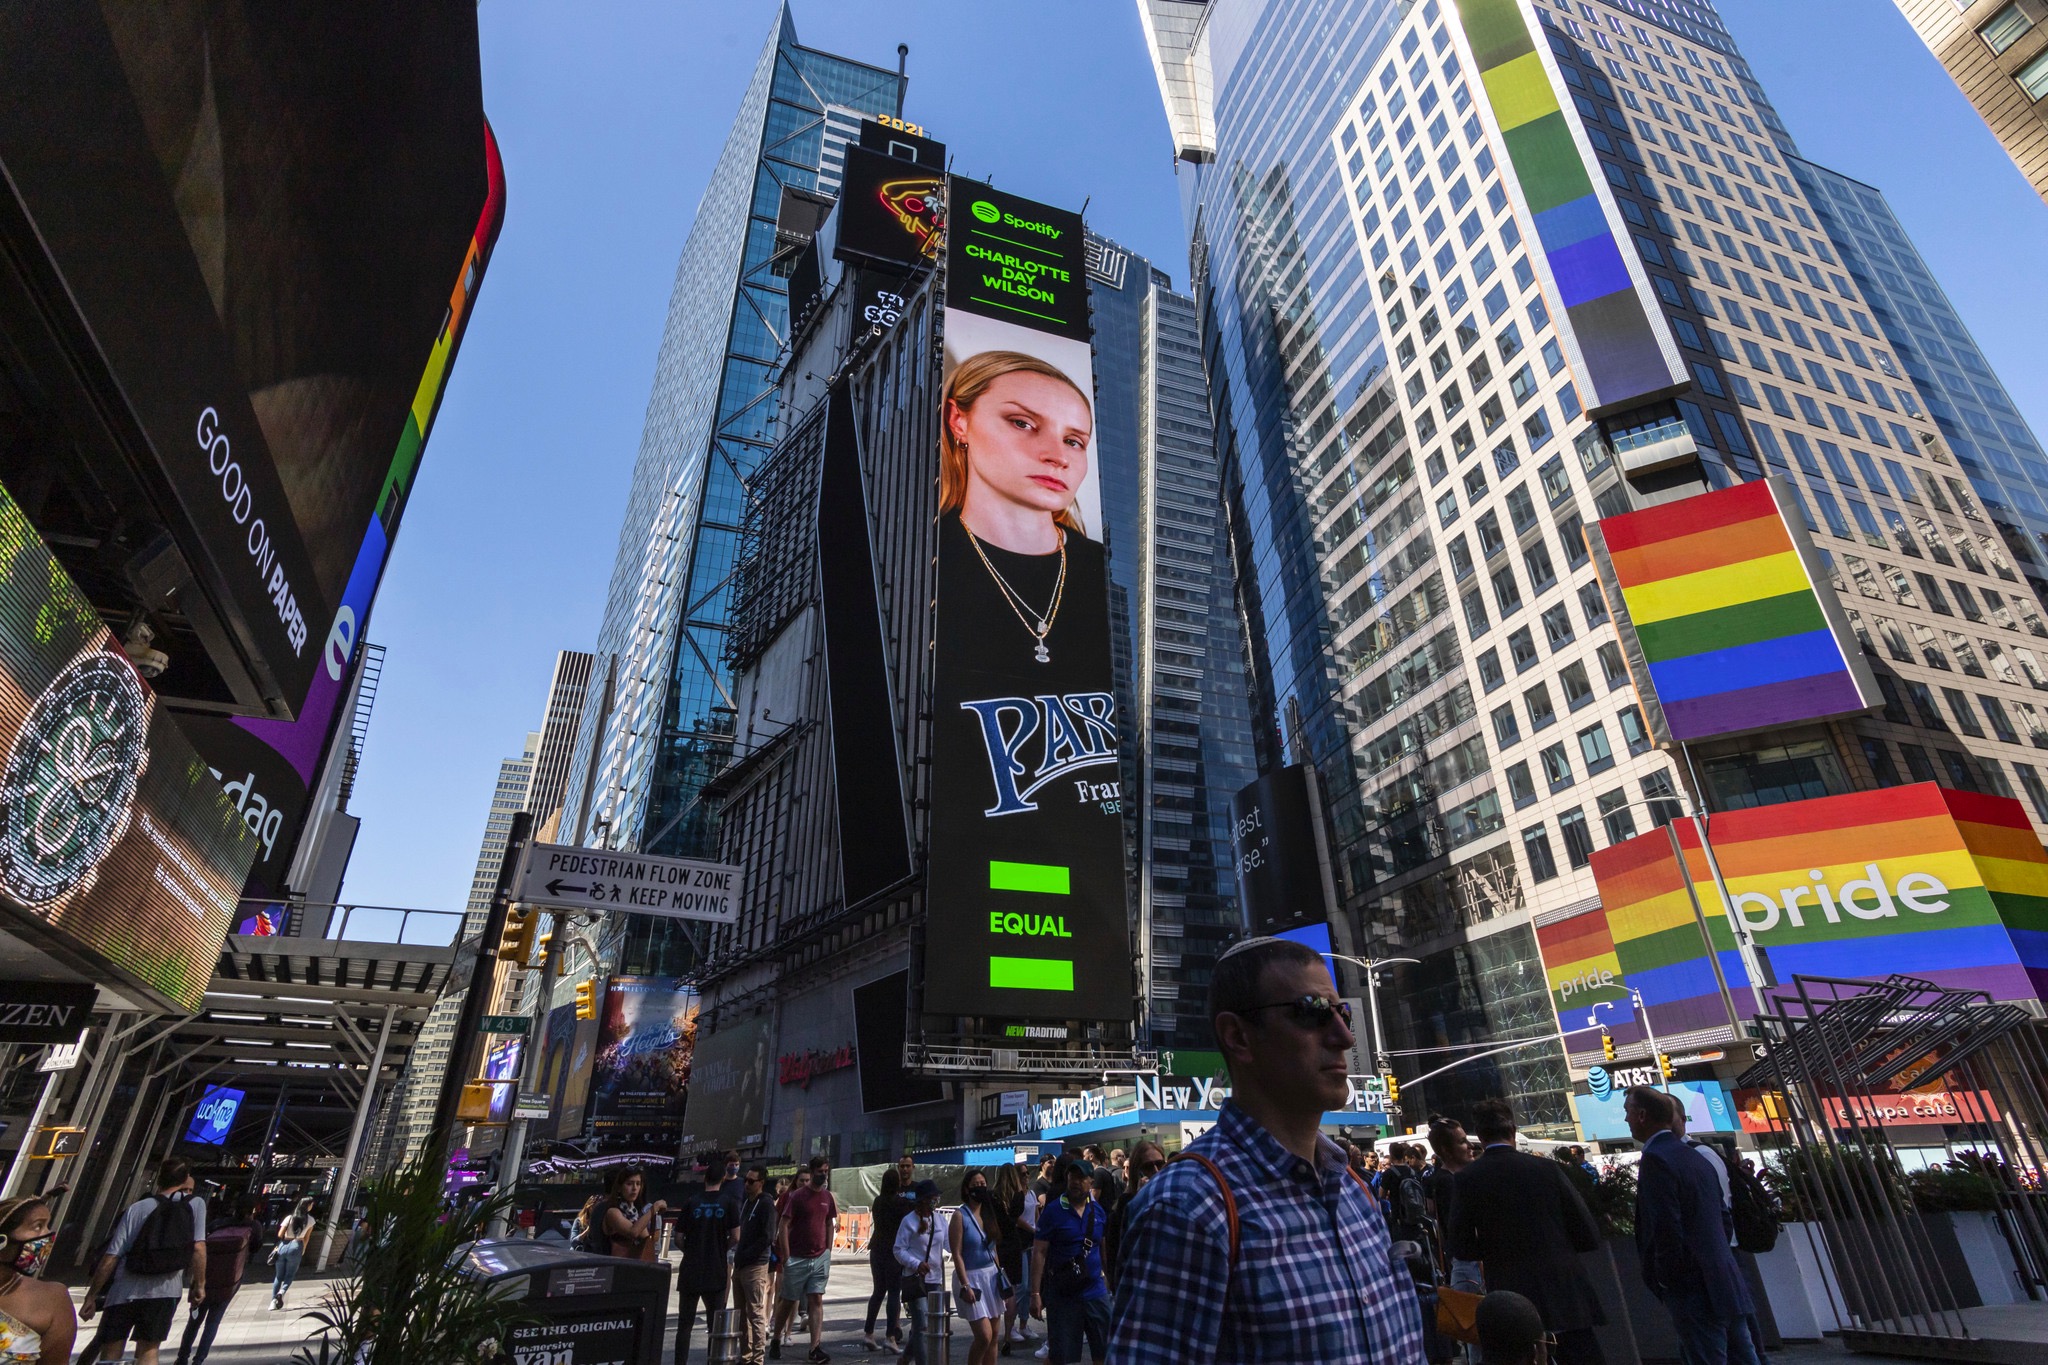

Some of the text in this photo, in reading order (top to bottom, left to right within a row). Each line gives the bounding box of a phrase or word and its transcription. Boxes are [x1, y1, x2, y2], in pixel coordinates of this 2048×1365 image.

[878, 114, 923, 137] 2021
[1003, 213, 1062, 239] Spotify
[965, 244, 1070, 283] CHARLOTTE
[1002, 267, 1036, 286] DAY
[982, 275, 1055, 304] WILSON
[197, 406, 307, 658] GOOD ON PAPER
[208, 766, 283, 862] daq
[1230, 806, 1262, 848] atest
[549, 853, 733, 891] PEDESTRIAN FLOW ZONE
[629, 887, 729, 914] KEEP MOVING
[1731, 863, 1951, 948] pride
[989, 911, 1072, 938] EQUAL
[1559, 967, 1614, 1003] pride
[0, 1003, 76, 1026] ZEN
[481, 1018, 491, 1031] W
[496, 1018, 513, 1032] 43
[621, 1029, 681, 1057] Heights
[1614, 1066, 1654, 1088] AT&T
[569, 1320, 633, 1334] ORIGINAL
[514, 1341, 575, 1353] Immersive
